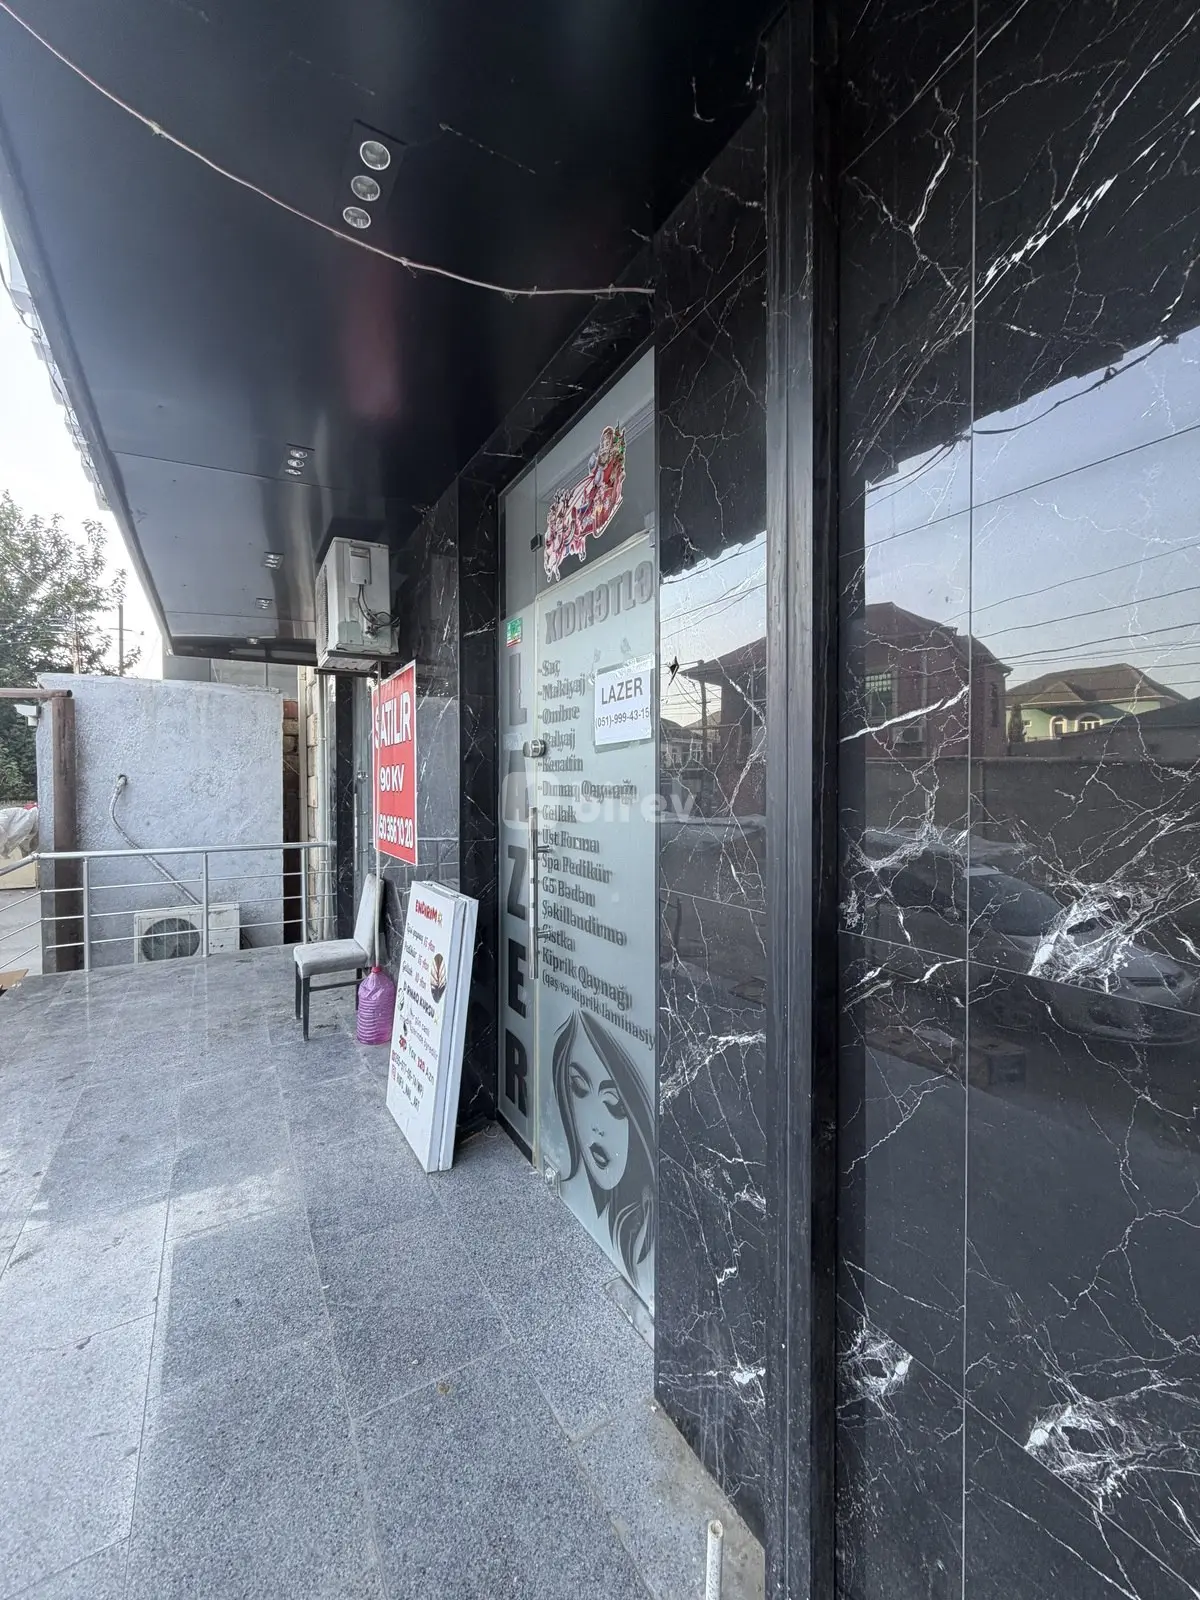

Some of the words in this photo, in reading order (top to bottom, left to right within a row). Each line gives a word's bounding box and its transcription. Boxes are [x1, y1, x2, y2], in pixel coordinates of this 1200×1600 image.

[601, 677, 643, 705] LAZER
[374, 691, 412, 749] SATILIR
[596, 707, 650, 729] (051)-999-43-15
[380, 766, 391, 792] 90
[392, 764, 405, 792] KV
[542, 853, 561, 874] Spa
[562, 857, 612, 884] Pedikür
[543, 947, 577, 980] Kiprik
[578, 966, 632, 1011] Qaynağı
